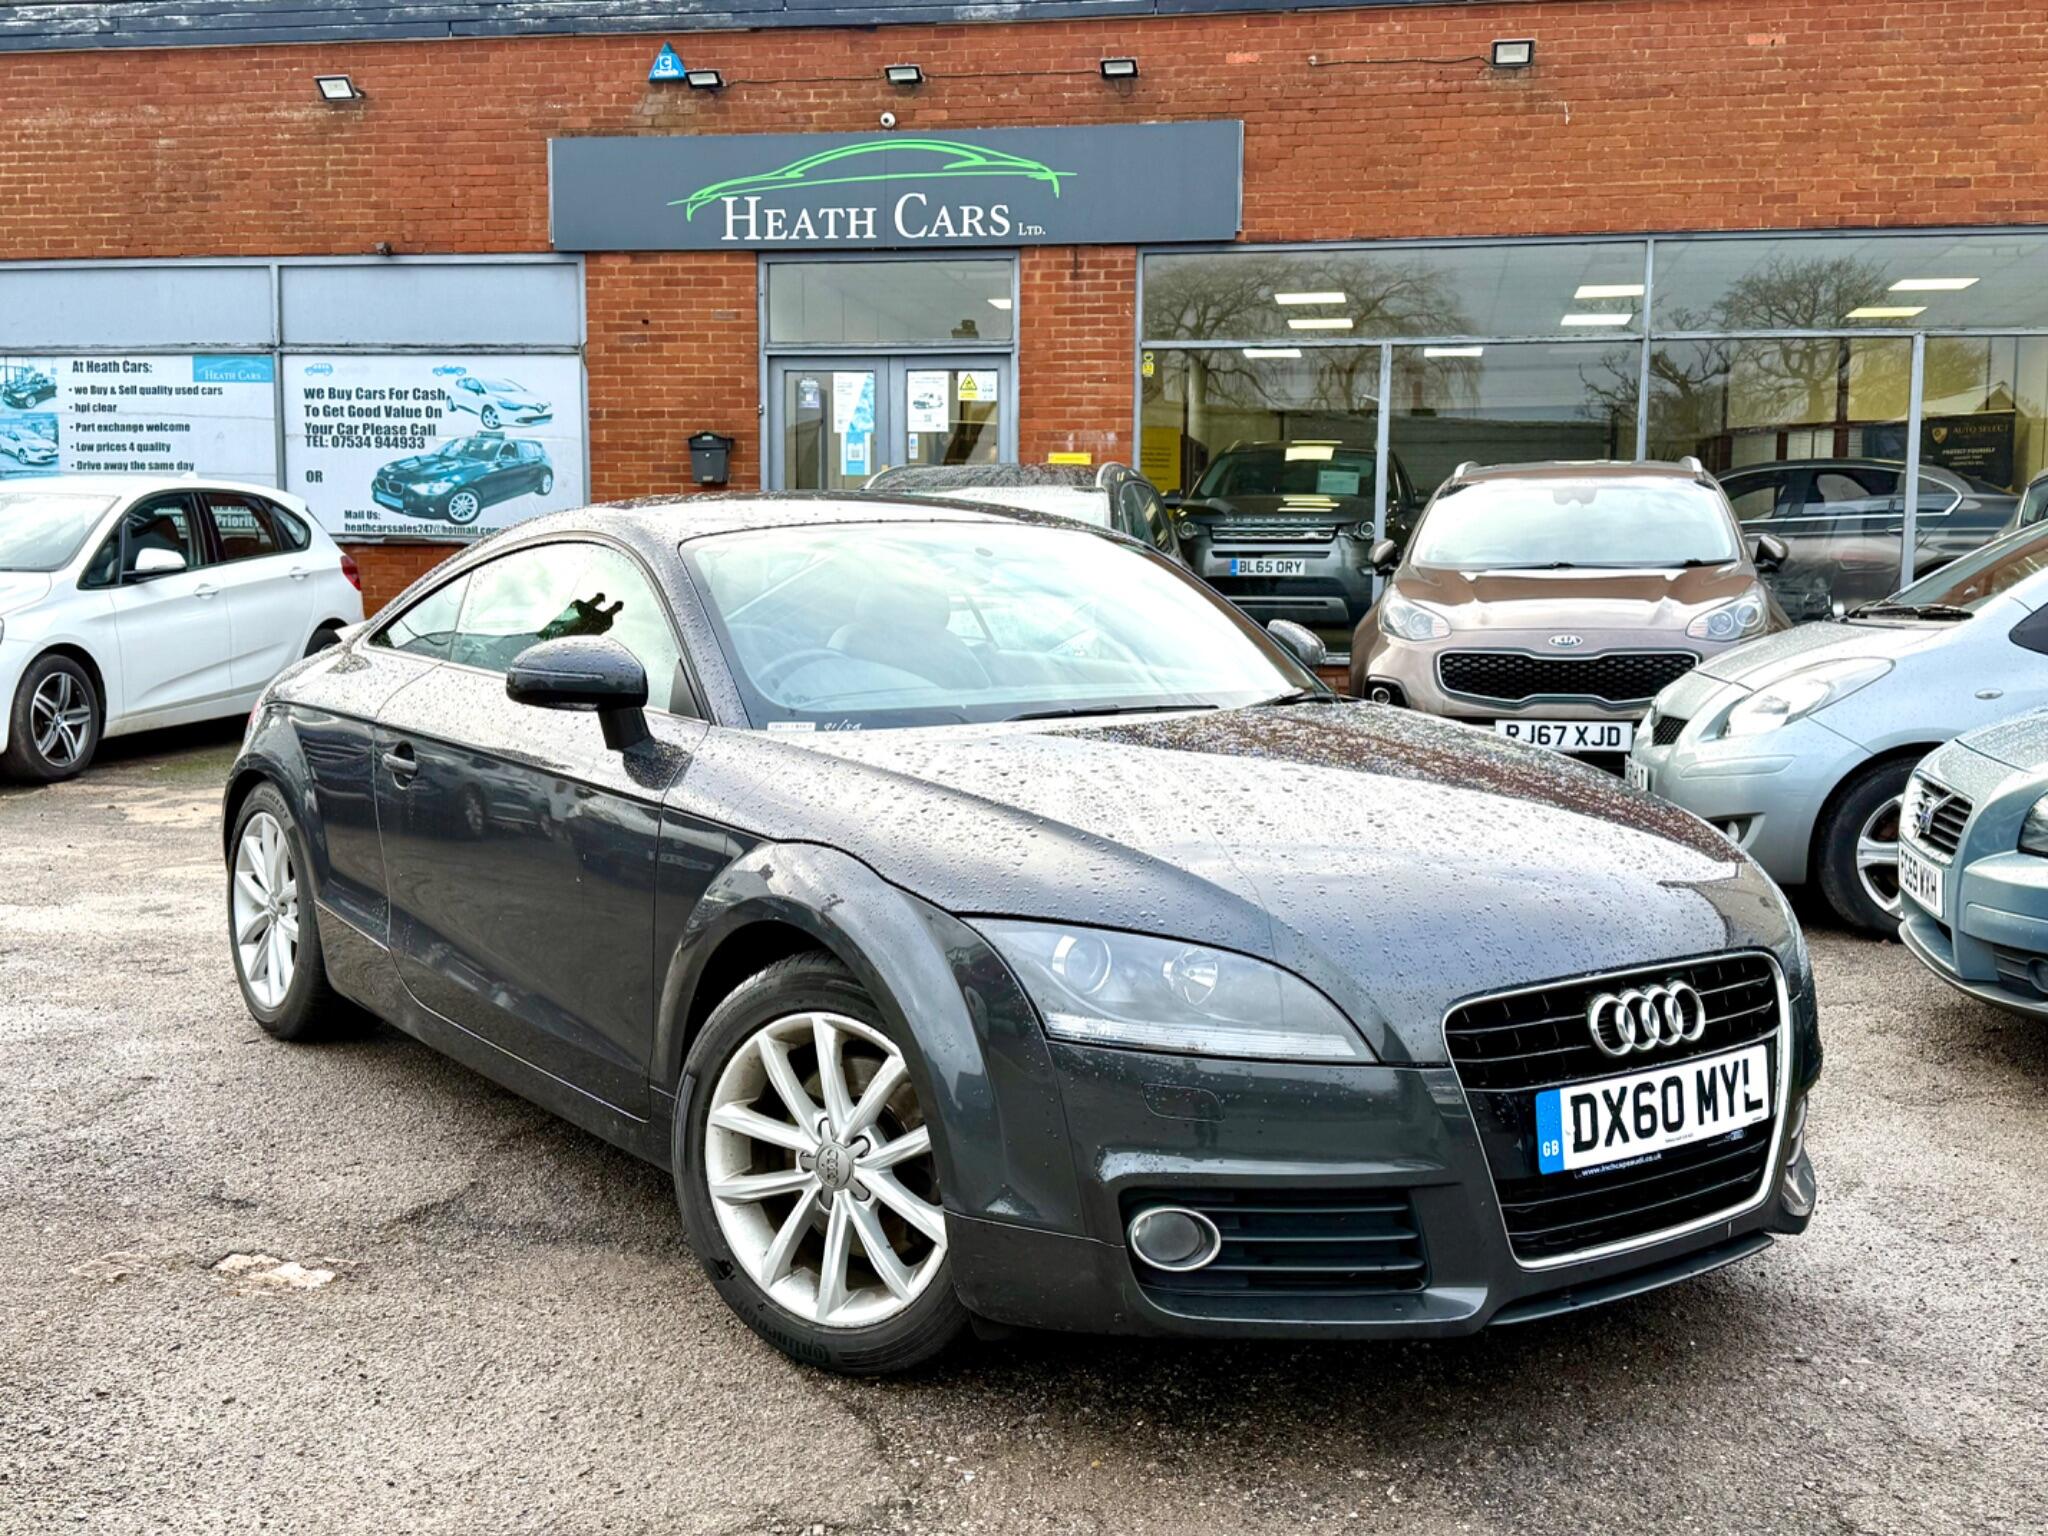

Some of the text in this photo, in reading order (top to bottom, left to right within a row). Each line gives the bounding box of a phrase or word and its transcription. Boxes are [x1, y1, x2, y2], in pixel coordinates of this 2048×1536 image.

[720, 196, 878, 240] HEATH
[894, 192, 1011, 238] CARS
[72, 360, 153, 374] At Heath Cars:
[90, 385, 108, 396] Buy
[118, 385, 137, 395] Sell
[139, 385, 173, 396] quality
[174, 385, 199, 396] used
[200, 386, 224, 396] cars
[328, 387, 352, 401] Buy
[355, 387, 386, 400] Cars
[388, 388, 410, 400] For
[92, 402, 118, 412] clear
[304, 404, 442, 418] To Get Good Value On
[76, 422, 191, 434] Part exchange welcome
[304, 422, 436, 436] Your Car Please Call
[76, 442, 172, 453] Low prices 4 quality
[304, 436, 426, 449] TEL: 07534 944933
[76, 460, 195, 472] Drive away the same day
[306, 470, 324, 484] OR
[344, 510, 381, 520] Mail Us:
[1240, 560, 1302, 573] BL65 ORY
[1554, 634, 1578, 644] KIA
[1574, 726, 1621, 746] XJD
[1570, 1058, 1764, 1153] DX60 MYL
[1542, 1140, 1560, 1157] GB
